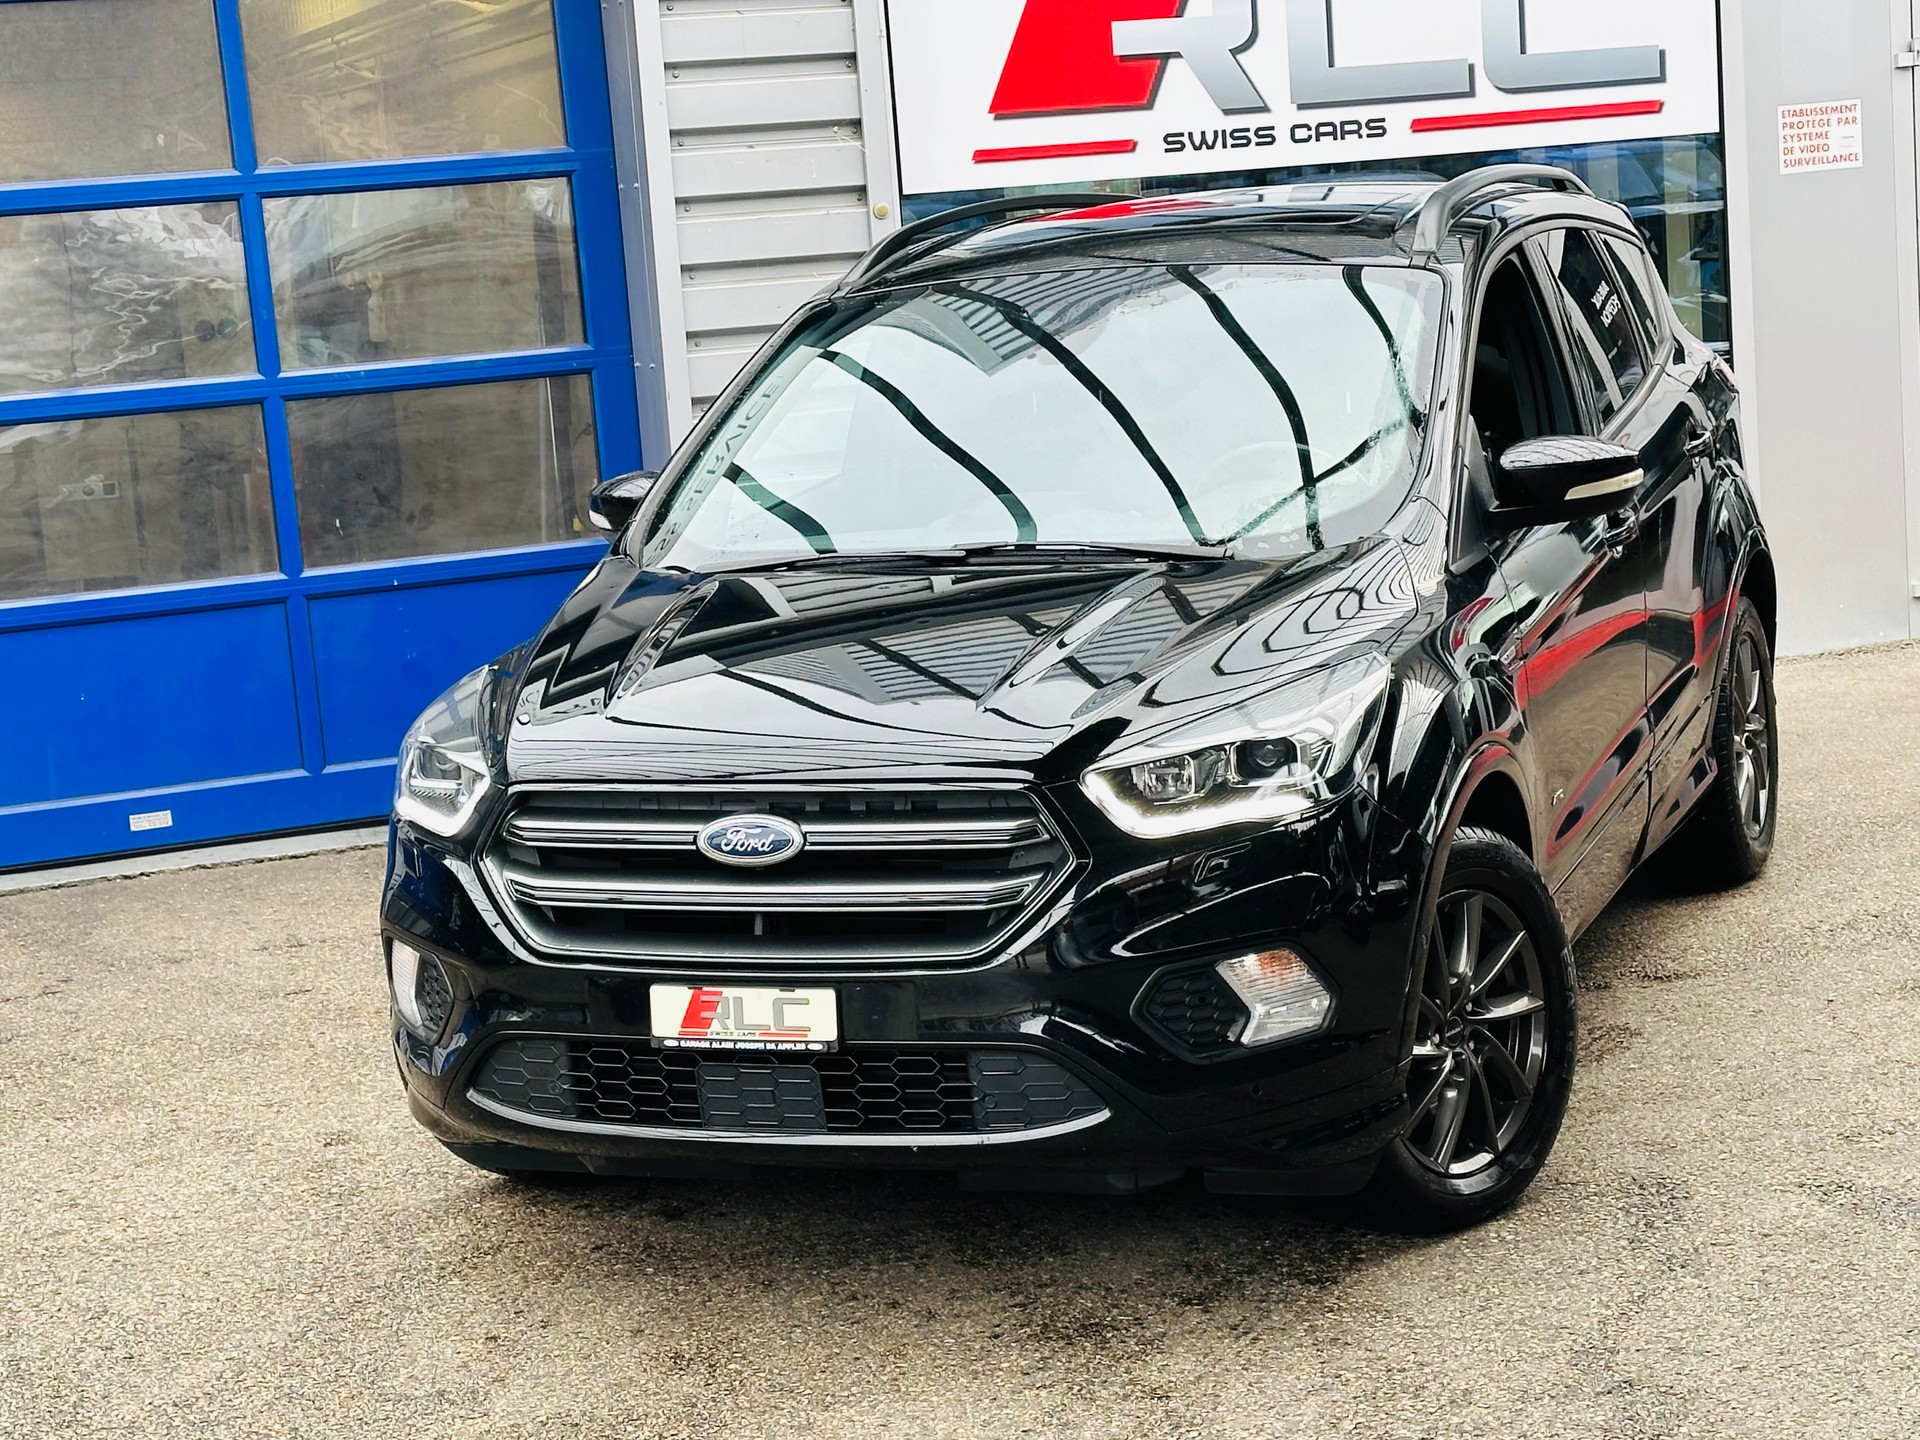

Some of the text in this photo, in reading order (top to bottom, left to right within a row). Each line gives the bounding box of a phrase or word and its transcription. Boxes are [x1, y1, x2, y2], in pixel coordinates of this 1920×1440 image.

[1781, 104, 1858, 119] ETABLISSEMENT
[1782, 116, 1858, 131] PROTEGE PAR
[1162, 117, 1388, 153] SWISS CARS
[1782, 131, 1830, 144] SYSTEME
[1783, 143, 1830, 156] DE VIDEO
[1783, 153, 1860, 168] SURVEILLANCE
[720, 827, 775, 852] Ford
